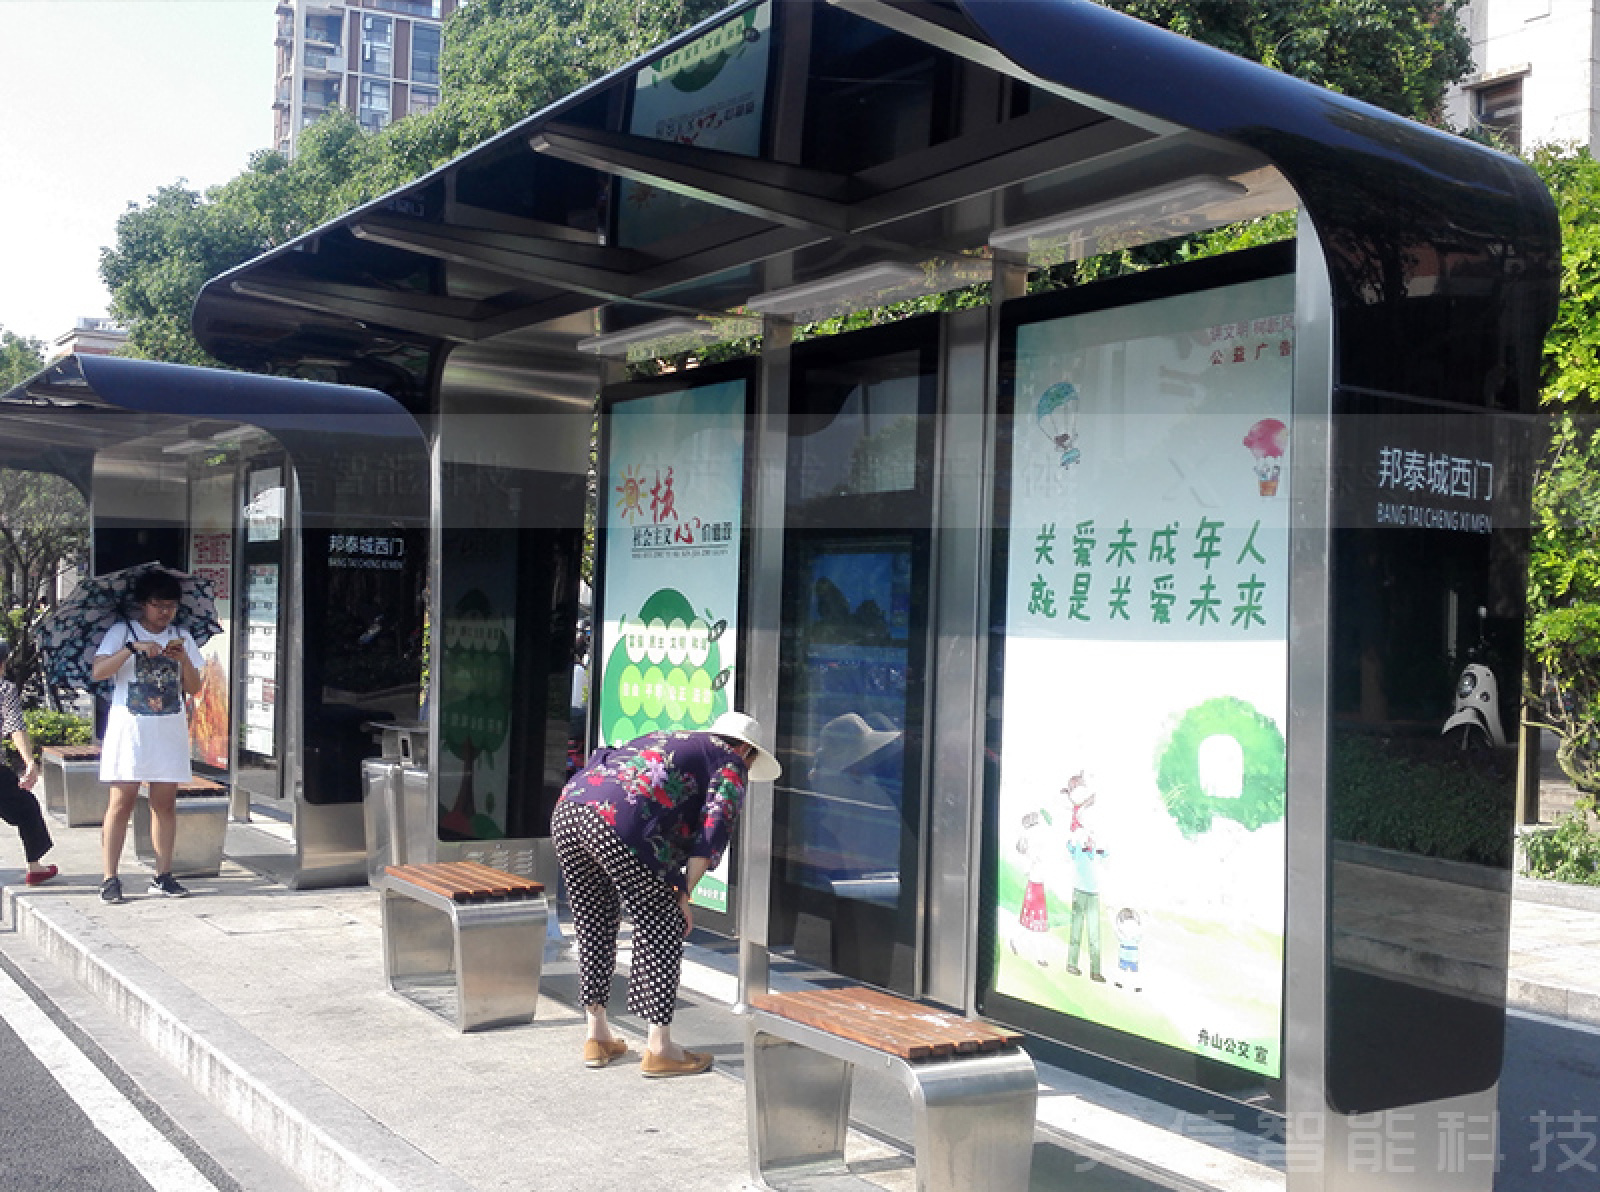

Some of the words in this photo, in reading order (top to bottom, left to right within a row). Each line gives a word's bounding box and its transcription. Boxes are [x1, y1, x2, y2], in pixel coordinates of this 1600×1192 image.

[1210, 340, 1291, 365] 公益广告
[1378, 446, 1494, 500] 邦泰城西门
[1034, 516, 1266, 569] 关爱未成年人
[1377, 502, 1406, 524] BANG
[1408, 505, 1423, 526] TAI
[1425, 507, 1459, 531] CHENG
[1028, 573, 1266, 630] 就是关爱未来
